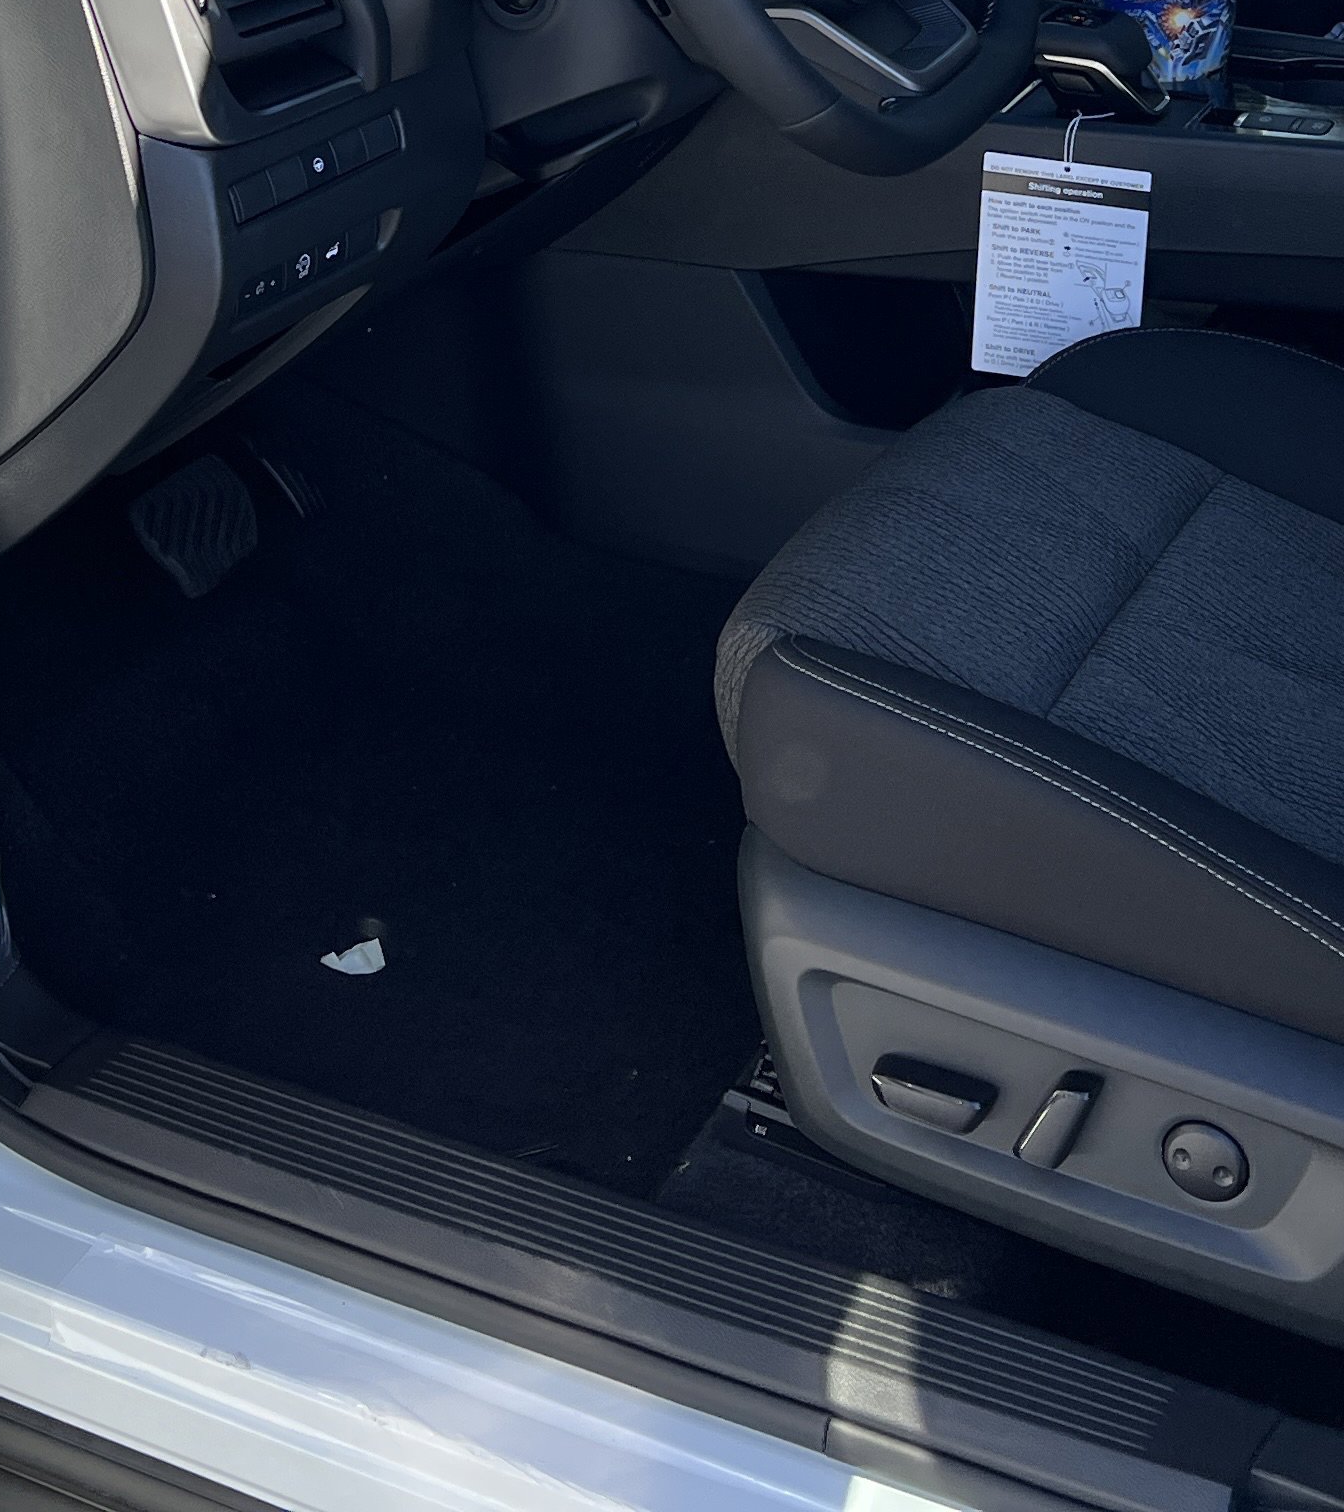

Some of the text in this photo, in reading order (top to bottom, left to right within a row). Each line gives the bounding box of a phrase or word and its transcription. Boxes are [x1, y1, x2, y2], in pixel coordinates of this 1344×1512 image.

[1028, 181, 1104, 199] Shifting operation
[992, 223, 1010, 231] Shift
[1020, 227, 1041, 235] PARK
[991, 243, 1009, 252] Shift
[1019, 248, 1055, 259] REVERSE
[988, 283, 1007, 292] Shift
[1016, 288, 1052, 299] NEUTRAL
[985, 343, 1003, 352] Shift
[1012, 347, 1036, 356] DRIVE
